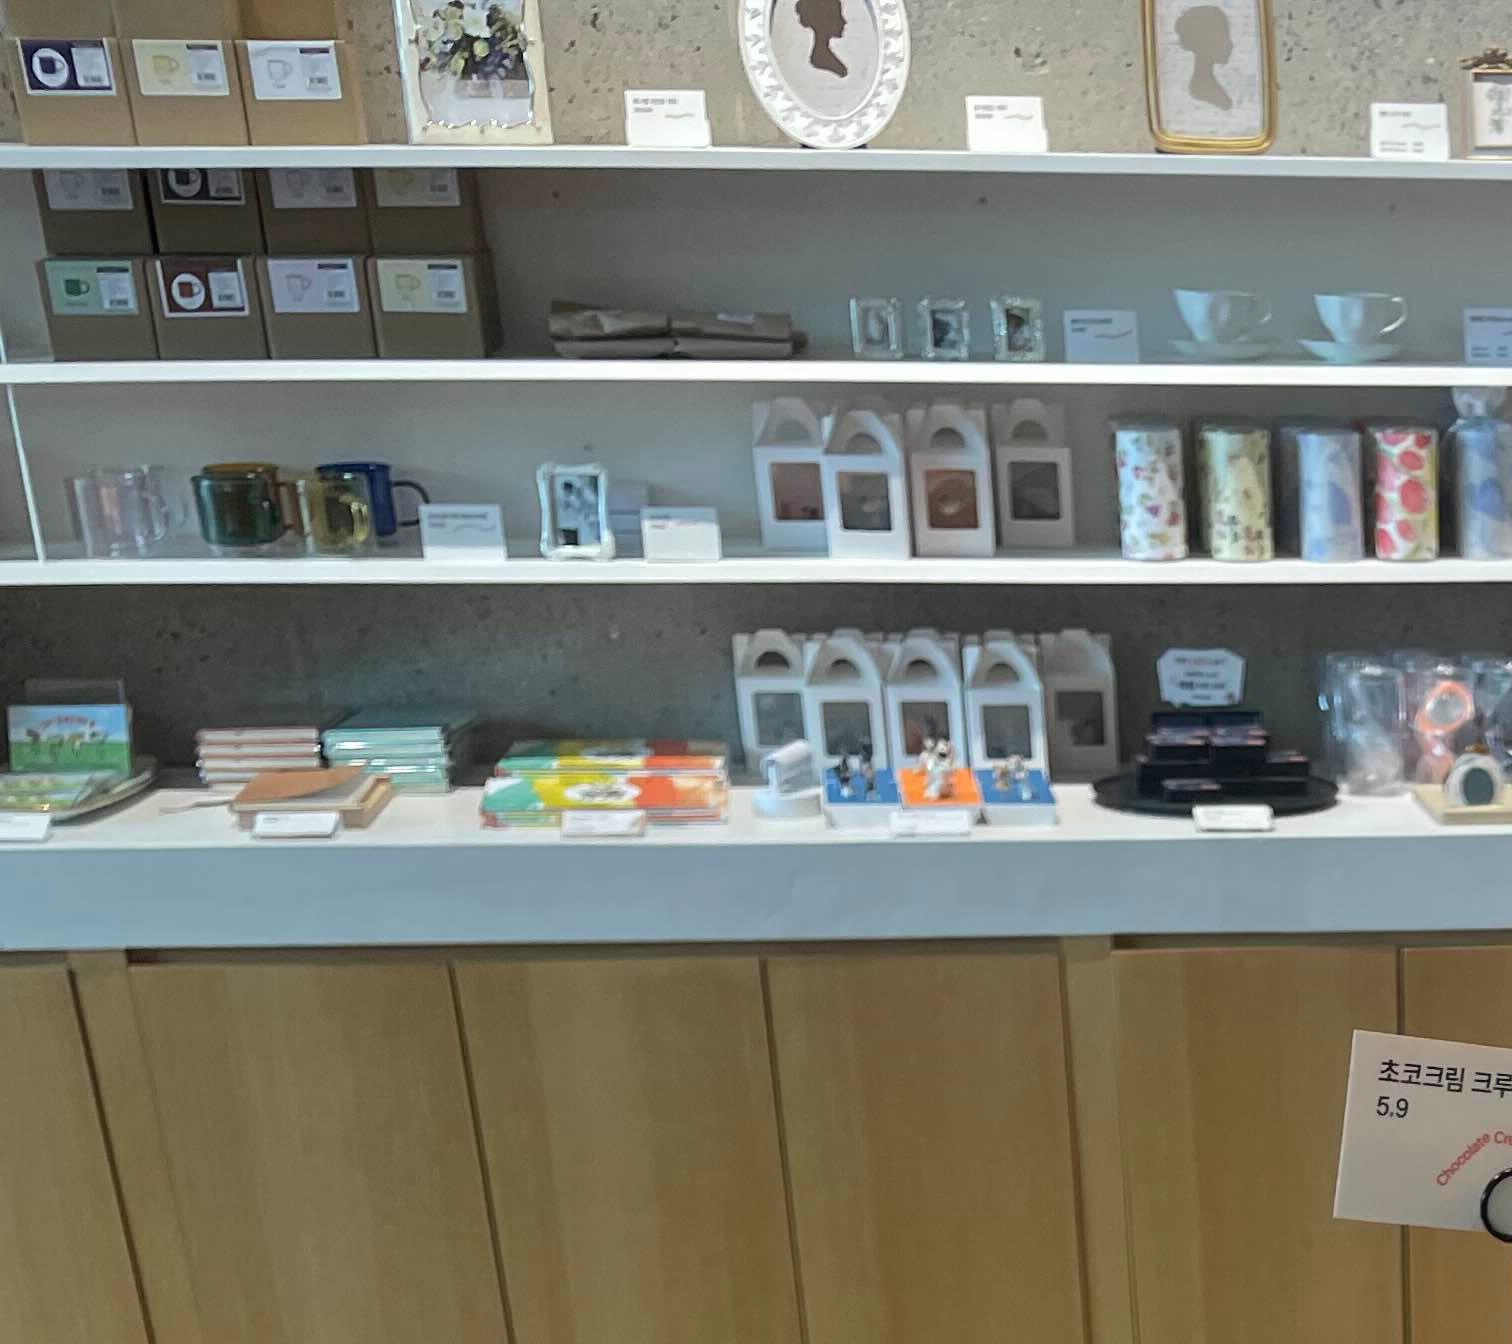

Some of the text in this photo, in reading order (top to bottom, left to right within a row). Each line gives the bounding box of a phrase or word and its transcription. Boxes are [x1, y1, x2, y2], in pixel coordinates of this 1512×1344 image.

[1378, 1059, 1465, 1092] 초코크림
[1376, 1096, 1409, 1118] 5.9
[1436, 1132, 1490, 1186] Chocolate
